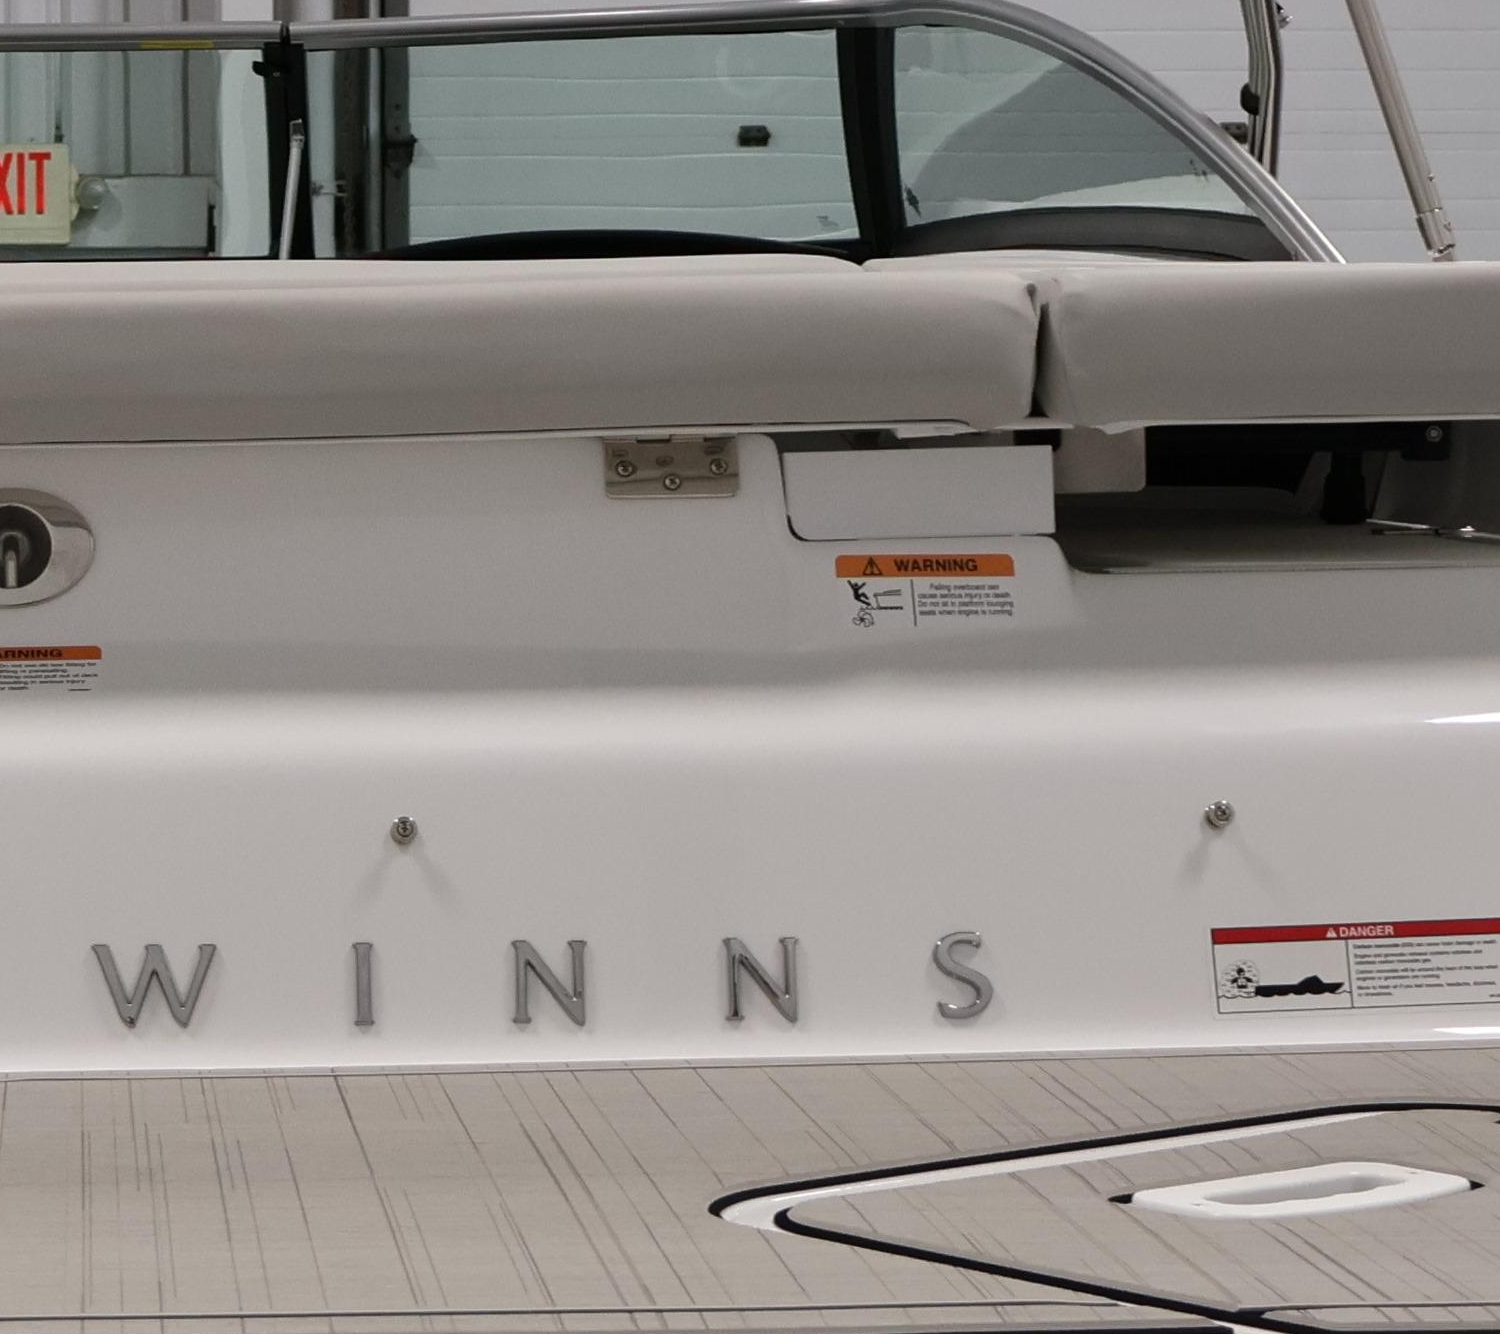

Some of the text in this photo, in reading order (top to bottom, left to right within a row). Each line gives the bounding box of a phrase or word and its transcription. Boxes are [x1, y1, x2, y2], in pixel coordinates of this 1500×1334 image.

[894, 559, 978, 572] WARNING
[1339, 924, 1394, 938] DANGER
[91, 930, 996, 1030] WINNS
